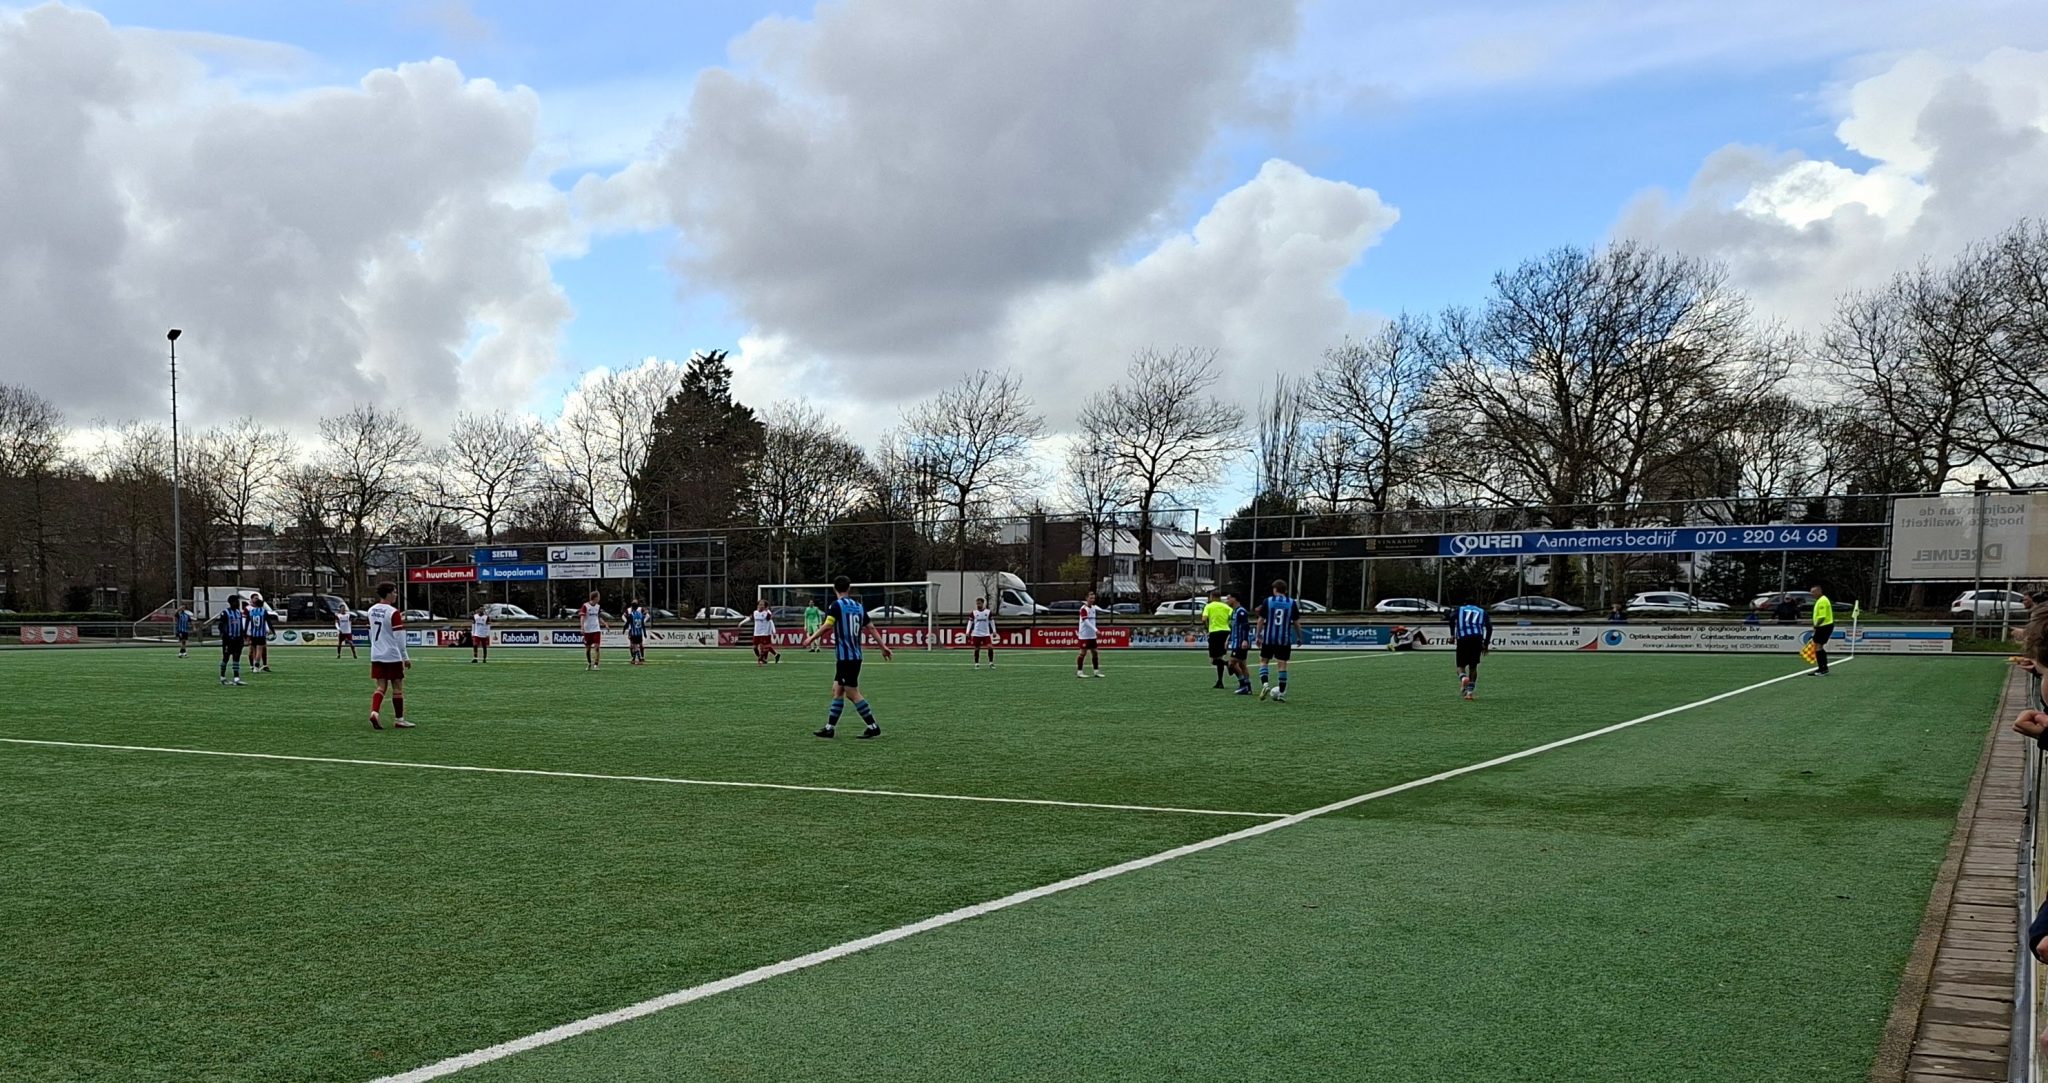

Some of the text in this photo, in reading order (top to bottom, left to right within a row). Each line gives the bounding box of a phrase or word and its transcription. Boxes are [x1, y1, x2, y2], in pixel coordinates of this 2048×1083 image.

[1696, 531, 1727, 545] 070
[1743, 530, 1774, 543] 220
[1780, 529, 1801, 543] 64
[1807, 528, 1828, 543] 68
[426, 569, 474, 579] huuralarm.nl
[493, 567, 544, 579] koopalarm.nl
[252, 615, 261, 627] 19
[1274, 608, 1285, 625] 3
[1464, 609, 1480, 625] 77
[374, 621, 382, 641] 7
[849, 614, 861, 637] 16
[502, 633, 538, 642] Rabobank
[688, 632, 695, 640] &
[1347, 628, 1378, 638] sports
[1774, 633, 1795, 641] Kolbe
